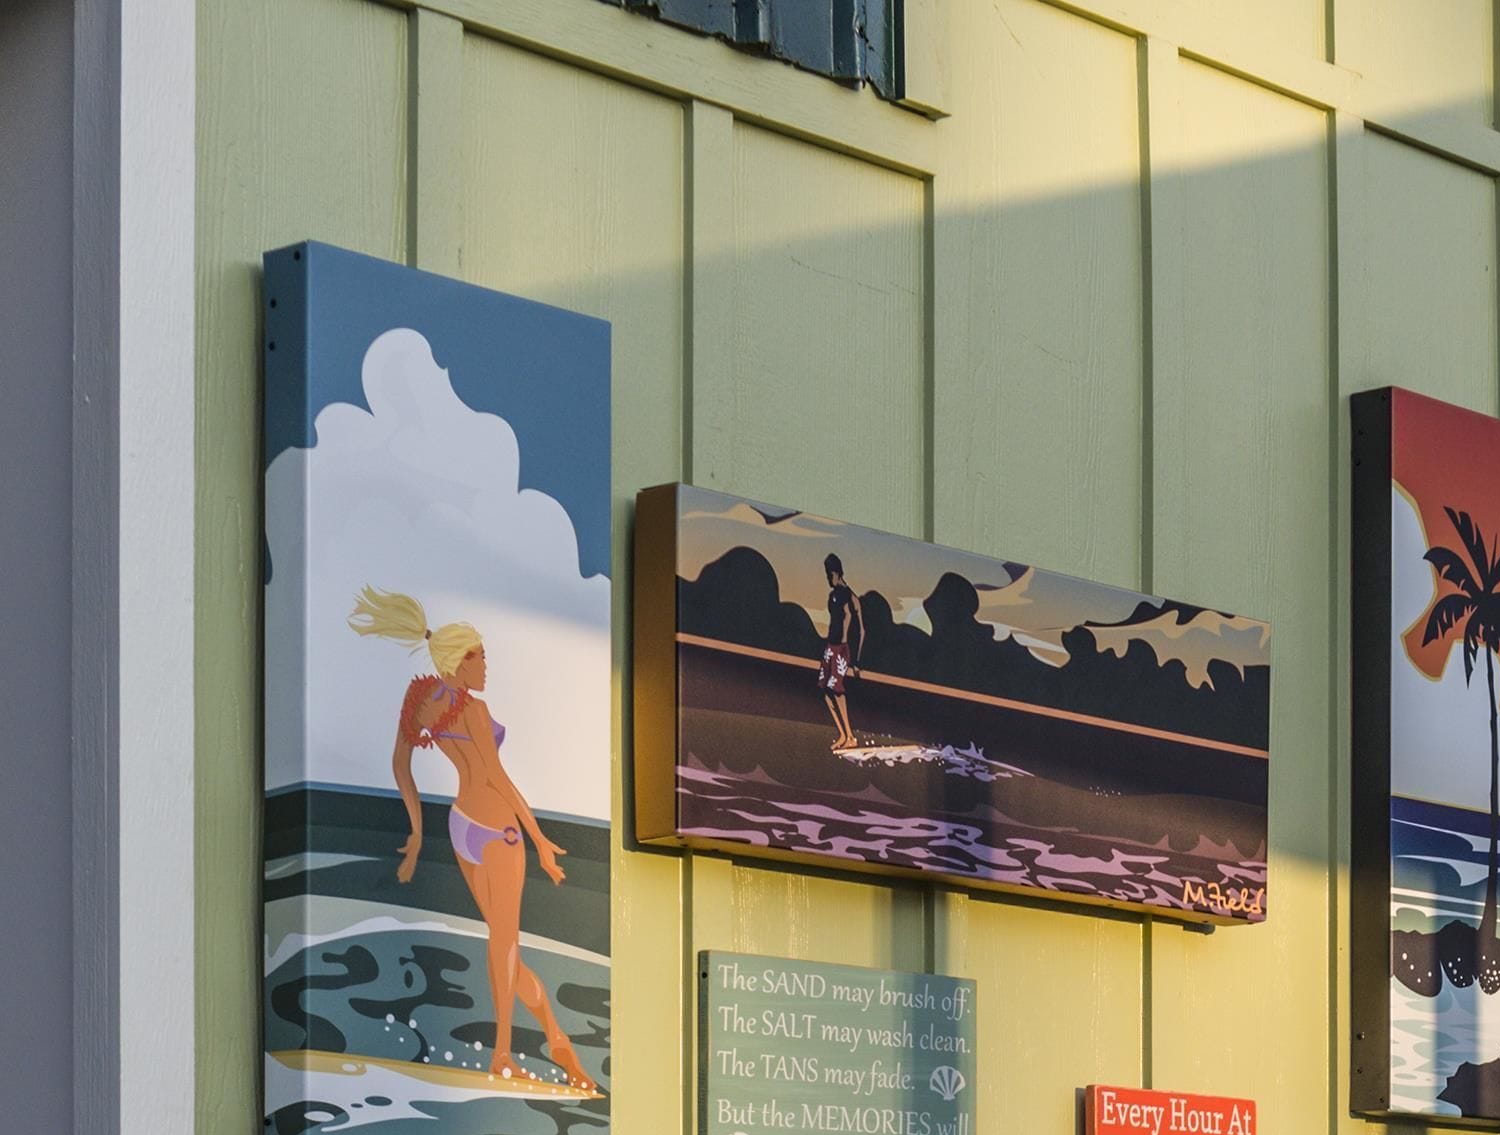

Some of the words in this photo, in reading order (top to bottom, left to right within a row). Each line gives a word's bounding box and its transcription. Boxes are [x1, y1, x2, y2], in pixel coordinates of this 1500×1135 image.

[717, 962, 757, 992] The
[762, 968, 826, 999] SAND
[832, 984, 874, 1012] may
[879, 979, 936, 1011] brush
[941, 986, 971, 1021] off.
[717, 1003, 757, 1034] The
[761, 1010, 817, 1040] SALT
[821, 1023, 862, 1053] may
[867, 1020, 914, 1049] wash
[920, 1023, 971, 1054] clean.
[717, 1048, 756, 1078] The
[760, 1054, 818, 1082] TANS
[824, 1067, 866, 1095] may
[865, 1060, 916, 1096] fade.
[716, 1099, 755, 1127] But
[762, 1099, 796, 1128] the
[1169, 1098, 1223, 1134] Hour
